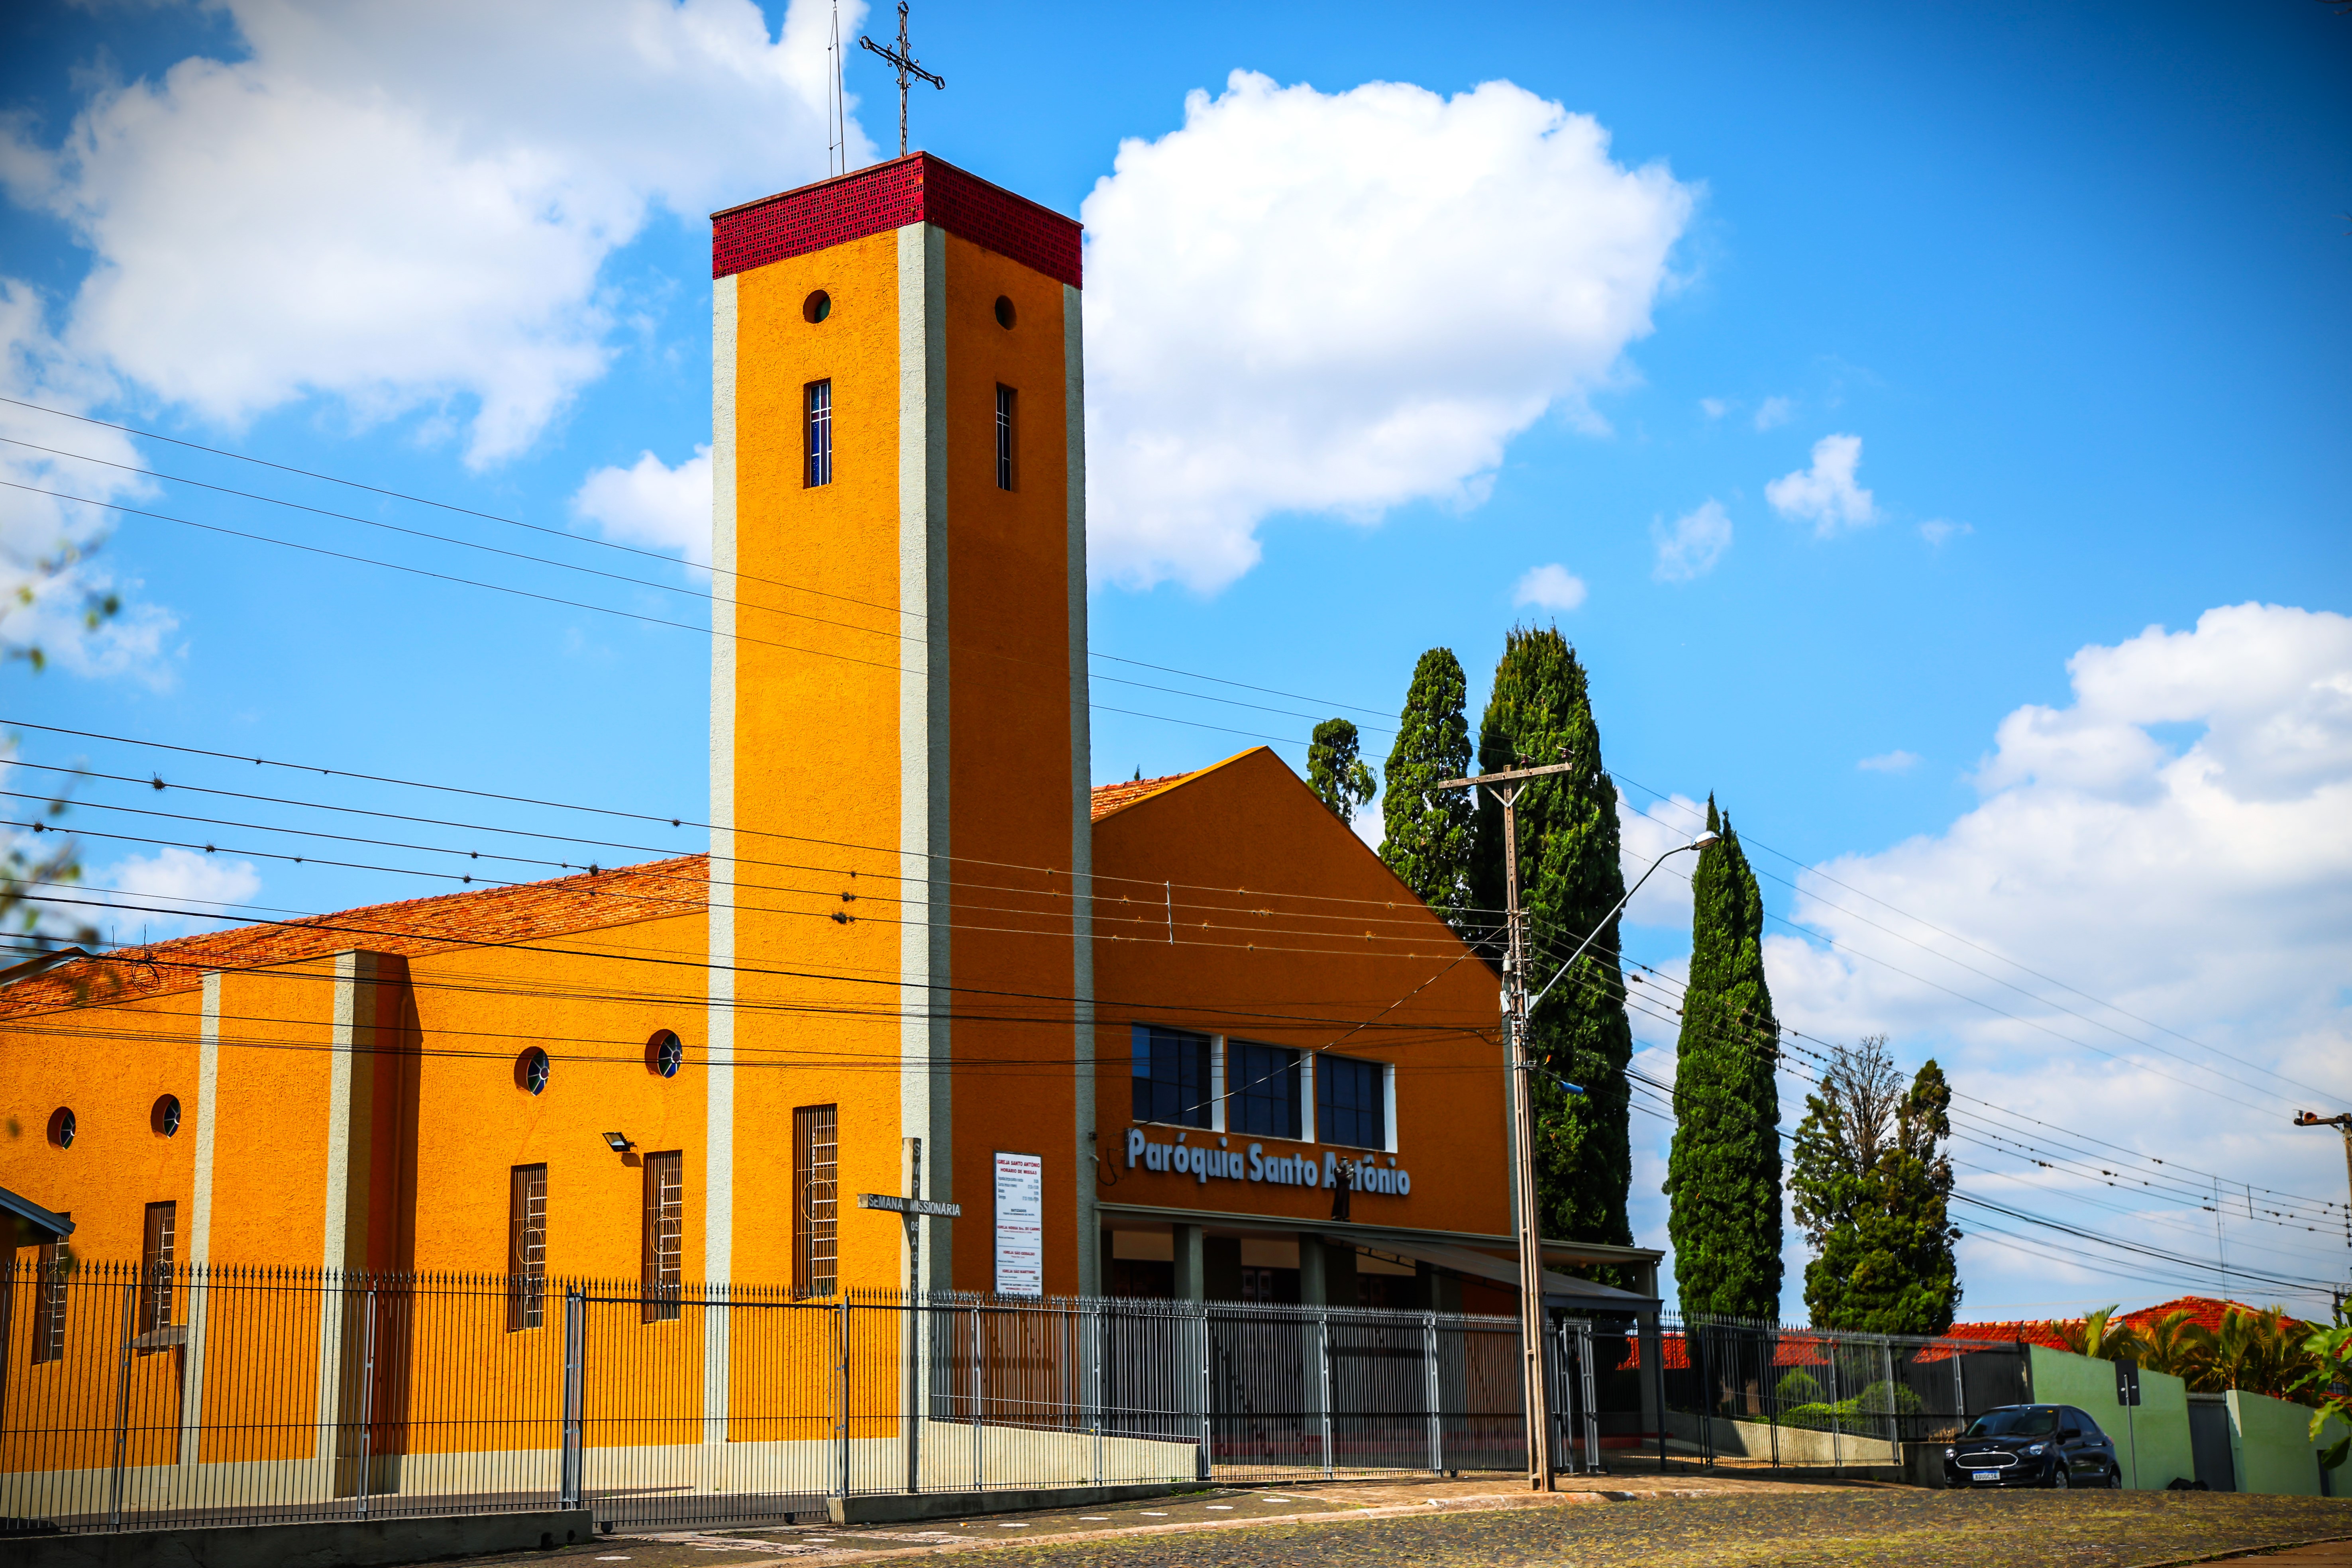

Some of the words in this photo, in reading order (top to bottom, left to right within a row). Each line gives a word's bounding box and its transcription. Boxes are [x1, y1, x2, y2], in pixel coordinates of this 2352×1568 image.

[1126, 1128, 1244, 1183] Paróquia
[1247, 1143, 1318, 1187] Santo
[1321, 1151, 1411, 1195] Atônio
[869, 1195, 903, 1210] SEMANA
[911, 1221, 919, 1231] 05
[912, 1237, 917, 1246] A
[911, 1252, 918, 1262] 12
